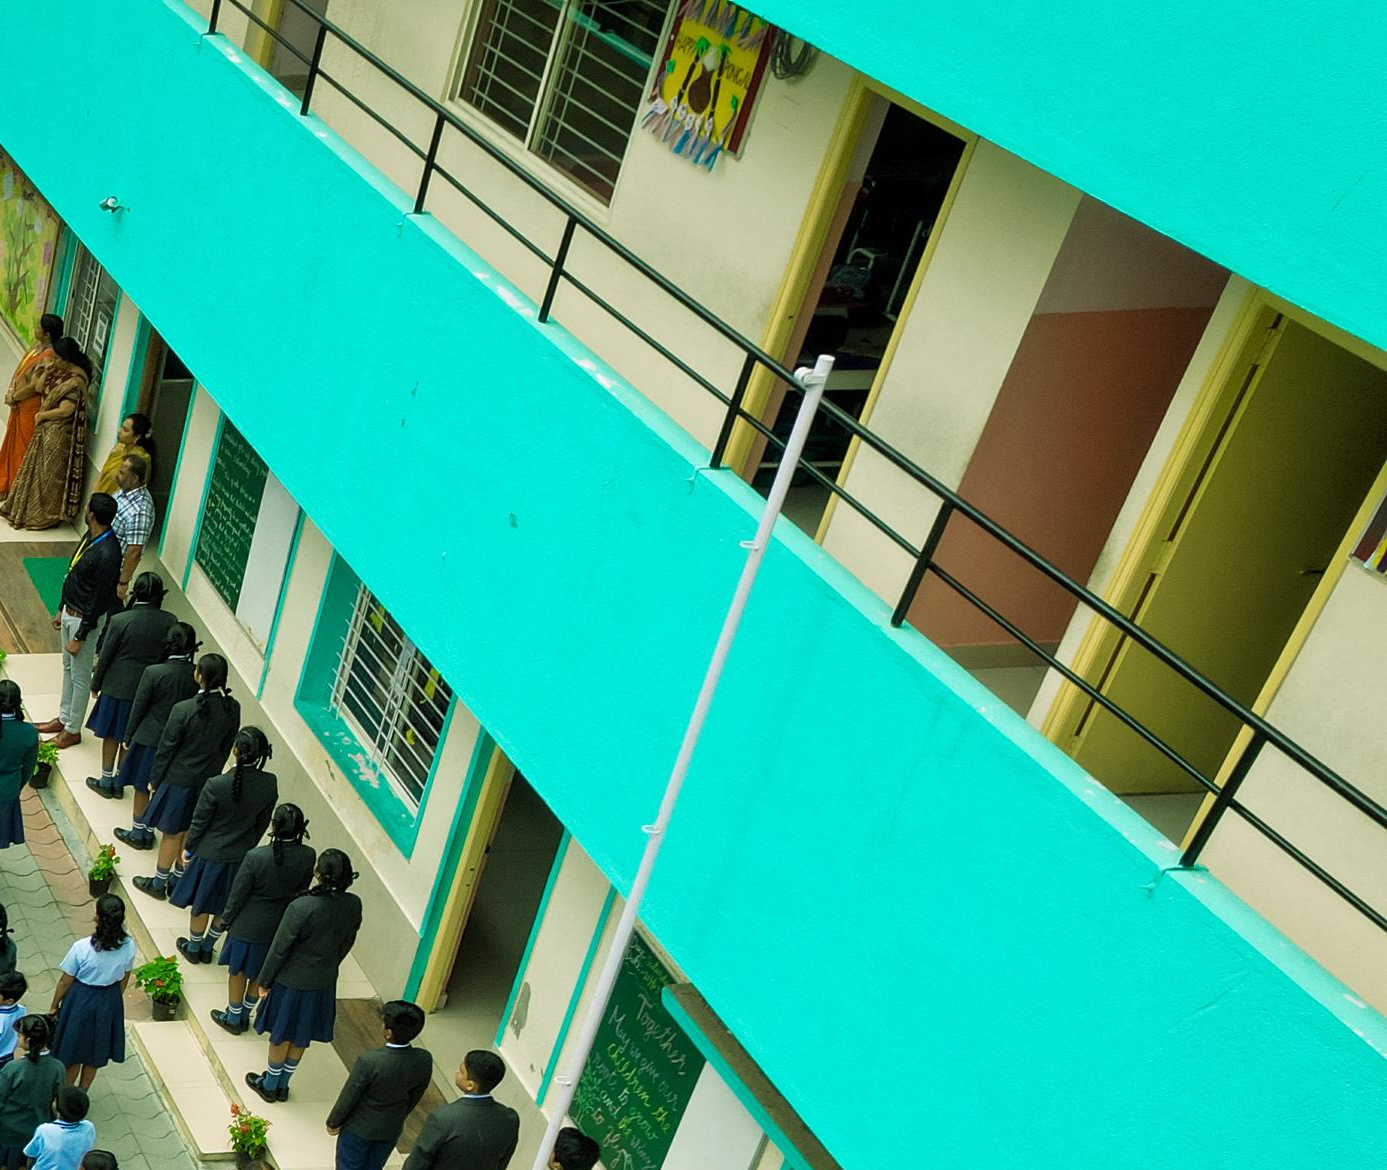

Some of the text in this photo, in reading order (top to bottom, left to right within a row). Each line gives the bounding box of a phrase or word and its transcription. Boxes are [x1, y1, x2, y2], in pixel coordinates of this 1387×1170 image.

[608, 1005, 630, 1052] May
[599, 1088, 620, 1120] and
[650, 1105, 670, 1134] the
[629, 1105, 658, 1141] grow
